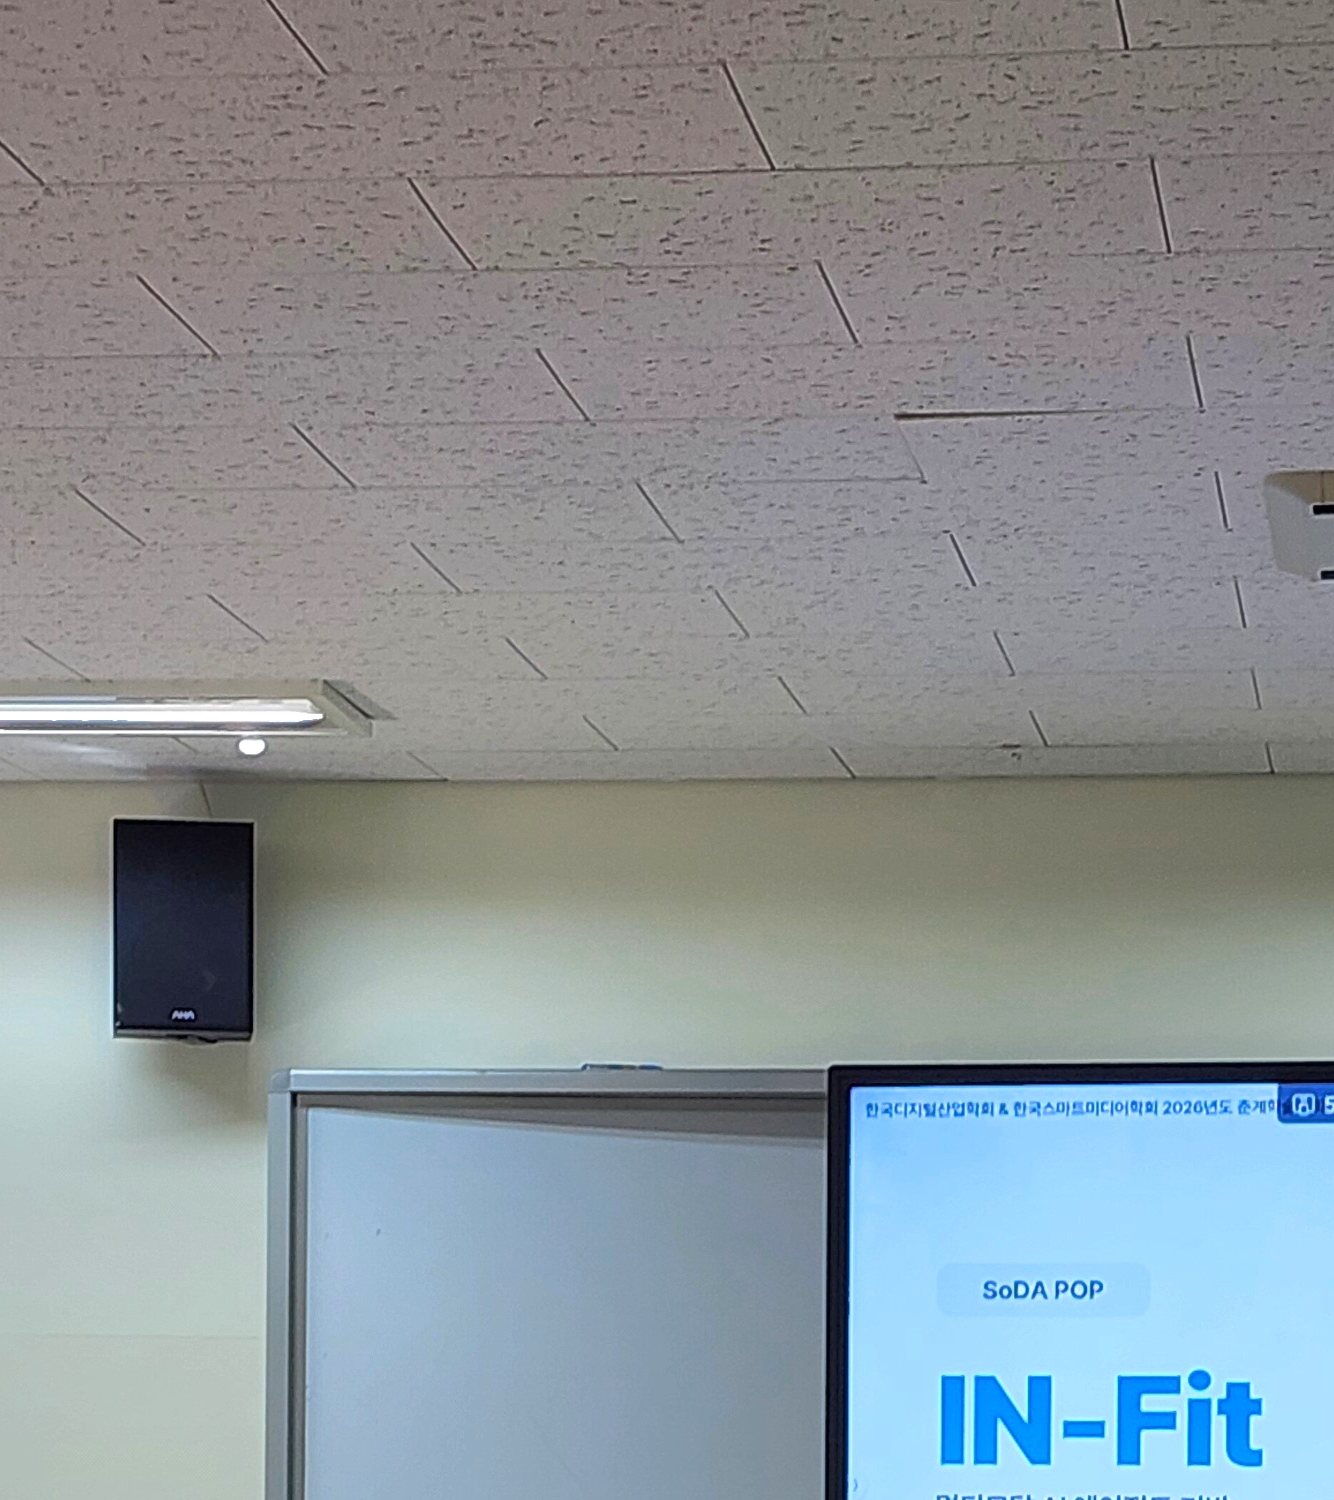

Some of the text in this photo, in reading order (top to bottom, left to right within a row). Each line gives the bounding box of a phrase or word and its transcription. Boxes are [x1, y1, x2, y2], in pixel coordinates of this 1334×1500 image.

[1014, 1099, 1158, 1118] 한국스마트미디어학회
[1163, 1099, 1233, 1117] 2026년도
[982, 1280, 1104, 1300] SoDA POP
[939, 1370, 1264, 1468] IN-Fit
